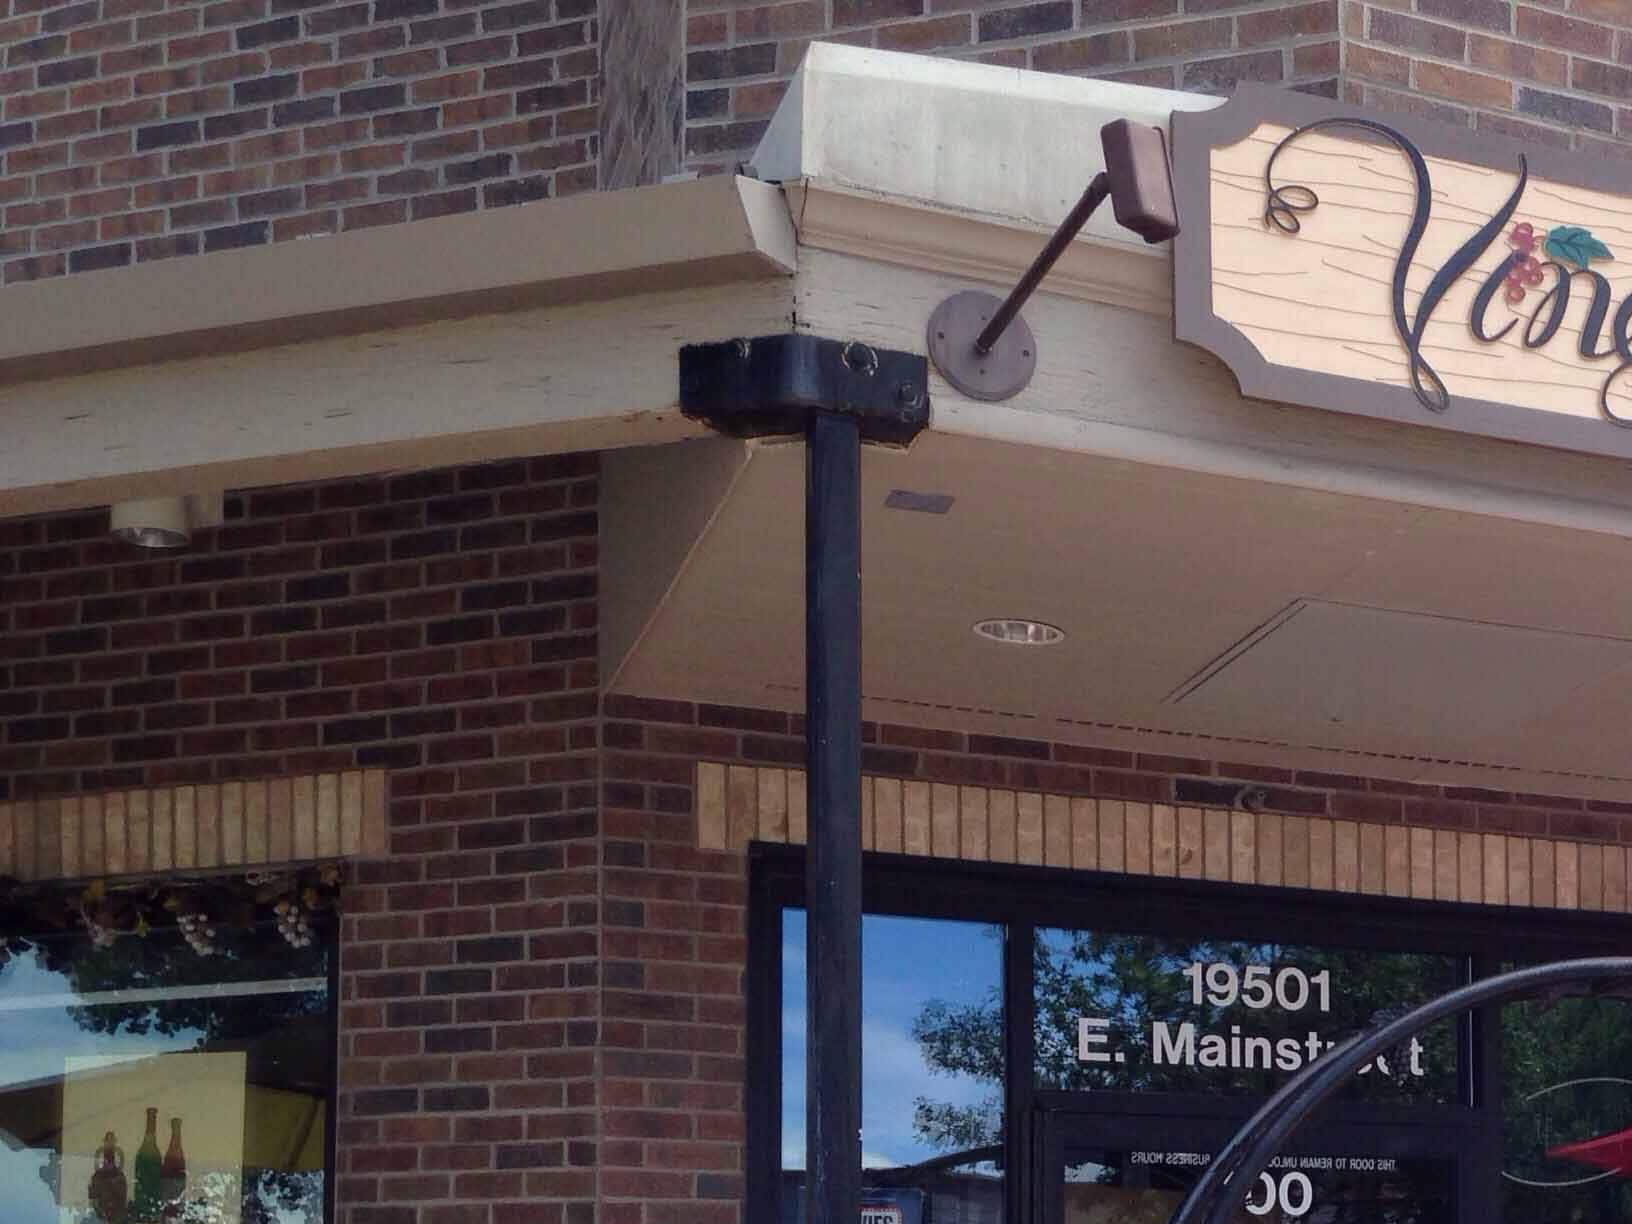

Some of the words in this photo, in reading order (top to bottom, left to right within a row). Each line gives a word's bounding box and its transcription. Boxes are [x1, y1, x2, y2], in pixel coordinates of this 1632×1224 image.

[1182, 962, 1330, 1012] 19501
[1078, 1017, 1125, 1063] E.
[1152, 1020, 1424, 1077] Mainstt
